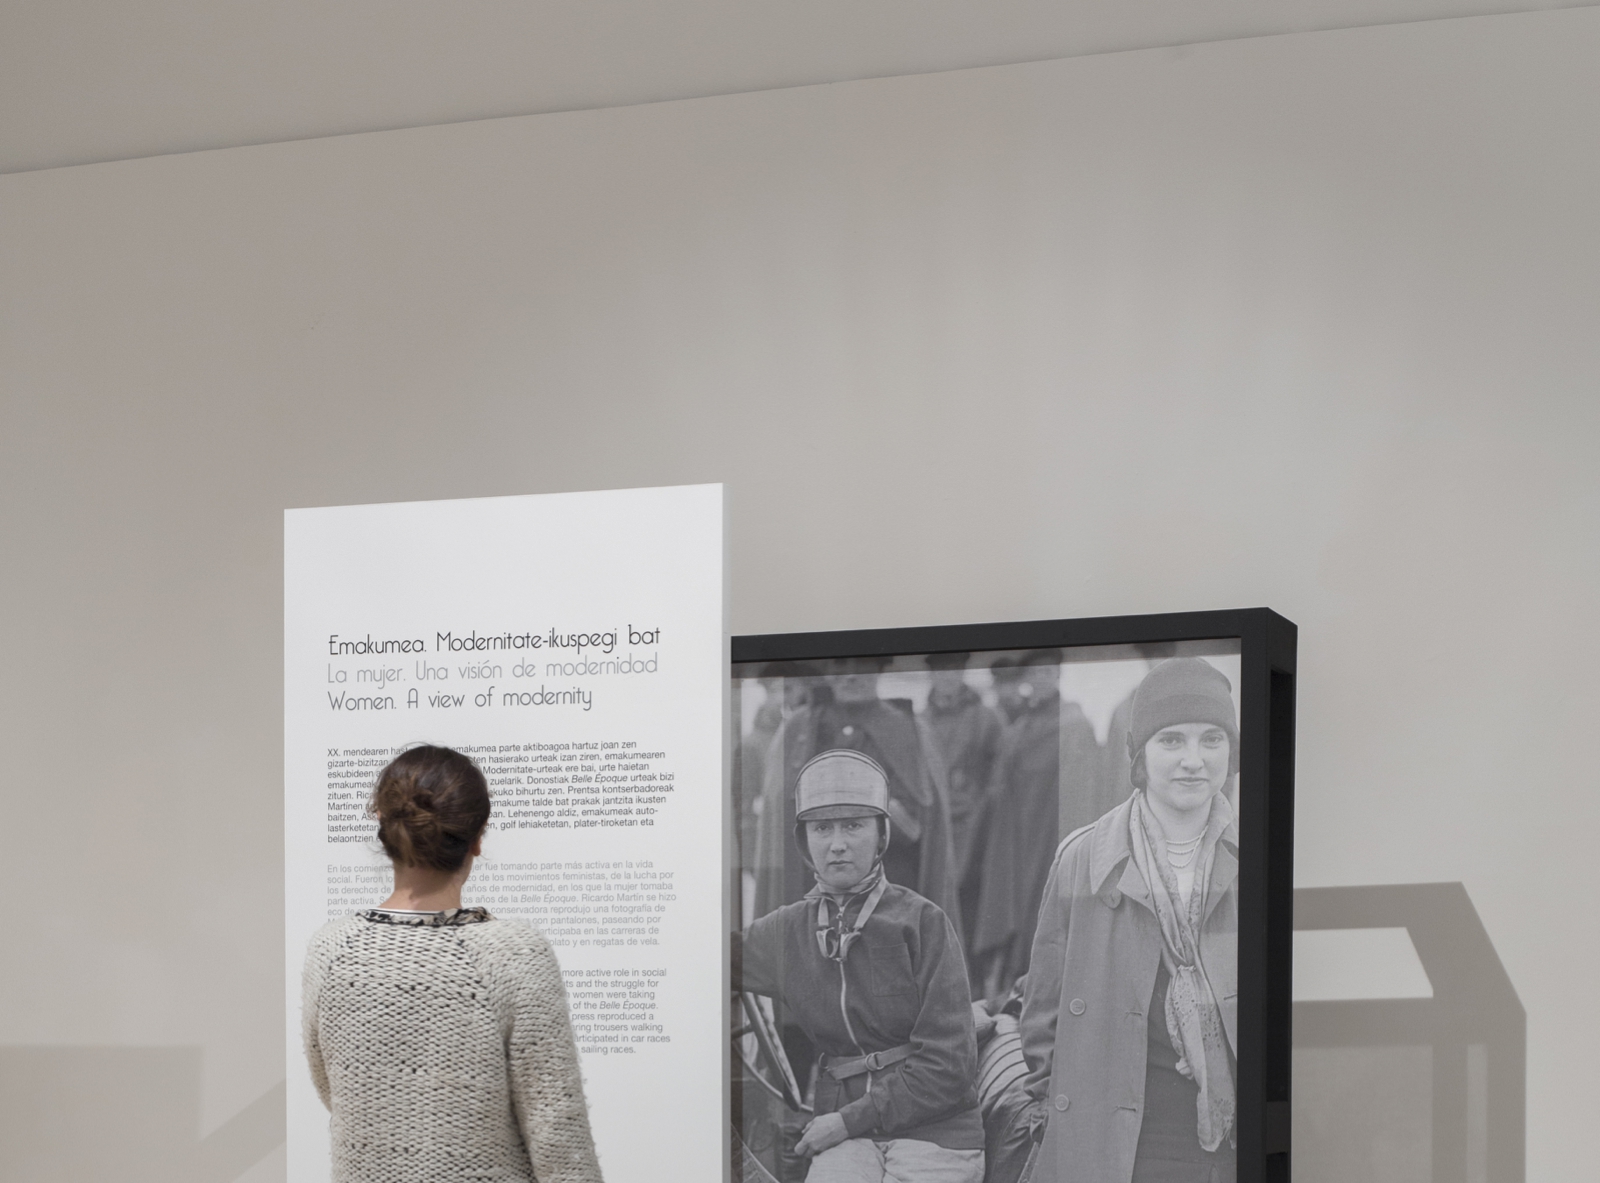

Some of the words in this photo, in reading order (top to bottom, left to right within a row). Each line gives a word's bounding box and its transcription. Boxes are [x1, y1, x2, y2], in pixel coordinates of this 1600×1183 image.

[328, 633, 427, 655] Emakumea.
[437, 627, 617, 655] Modernitate-ikuspegi
[629, 624, 660, 645] bat
[328, 663, 347, 683] La
[357, 665, 405, 690] mujer.
[416, 660, 448, 681] Una
[458, 660, 502, 679] visión
[512, 657, 536, 678] de
[546, 652, 657, 676] modernidad
[328, 687, 396, 711] Women.
[407, 688, 418, 709] A
[428, 690, 465, 708] view
[475, 685, 495, 707] of
[503, 684, 592, 711] modernity
[327, 748, 340, 757] XX.
[343, 747, 388, 756] mendearen
[499, 744, 521, 754] parte
[523, 742, 570, 754] aktiboagoa
[572, 742, 598, 750] hartuz
[601, 742, 619, 751] joan
[489, 754, 529, 764] hasierako
[531, 753, 558, 762] urteak
[560, 753, 577, 762] izan
[579, 752, 602, 761] ziren,
[605, 751, 665, 760] emakumearen
[327, 769, 374, 779] eskubideen
[483, 764, 563, 774] Modernitate-urteak
[581, 763, 596, 772] bai,
[599, 763, 616, 772] urte
[618, 762, 649, 771] haietan
[490, 776, 524, 786] zuelarik.
[527, 775, 569, 784] Donostiak
[571, 774, 593, 783] Belle
[595, 773, 628, 784] Époque
[630, 772, 657, 782] urteak
[660, 772, 674, 781] bizi
[328, 792, 353, 800] zituen.
[516, 787, 545, 796] bihurtu
[568, 785, 600, 794] Prentsa
[602, 783, 674, 794] kontserbadoreak
[328, 802, 363, 810] Martínen
[532, 797, 553, 806] talde
[556, 797, 569, 806] bat
[572, 796, 600, 807] prakak
[602, 796, 633, 807] jantzita
[636, 795, 666, 804] ikusten
[328, 813, 359, 821] baitzen,
[508, 809, 555, 821] Lehenengo
[557, 808, 579, 817] aldiz,
[581, 807, 633, 816] emakumeak
[636, 806, 658, 815] auto-
[500, 820, 516, 831] golf
[518, 820, 571, 829] lehiaketetan,
[574, 818, 638, 829] plater-tiroketan
[640, 818, 654, 826] eta
[328, 834, 374, 843] belaontzien
[328, 864, 337, 873] En
[485, 862, 498, 870] fue
[501, 862, 538, 870] tomando
[541, 862, 562, 871] parte
[565, 861, 582, 869] más
[585, 861, 610, 869] activa
[626, 860, 633, 868] la
[636, 860, 653, 868] vida
[327, 875, 352, 884] social.
[355, 873, 383, 883] Fueron
[479, 873, 490, 881] de
[492, 873, 504, 881] los
[507, 873, 560, 881] movimientos
[562, 872, 608, 880] feministas,
[624, 871, 631, 879] la
[634, 871, 657, 879] lucha
[660, 872, 674, 880] por
[327, 886, 339, 894] los
[341, 885, 378, 894] derechos
[381, 885, 391, 893] de
[467, 884, 487, 892] años
[489, 884, 500, 892] de
[502, 883, 555, 895] modernidad,
[571, 883, 583, 891] los
[586, 884, 602, 894] que
[604, 882, 611, 890] la
[614, 883, 638, 894] mujer
[640, 882, 673, 890] tomaba
[328, 897, 348, 906] parte
[475, 895, 495, 903] años
[498, 895, 508, 903] de
[511, 895, 518, 903] la
[520, 894, 541, 903] Belle
[544, 893, 578, 904] Époque.
[582, 893, 614, 902] Ricardo
[617, 893, 644, 901] Martín
[659, 893, 676, 901] hizo
[491, 905, 548, 915] conservadora
[551, 905, 591, 915] reprodujo
[612, 904, 652, 914] fotografía
[654, 904, 665, 912] de
[551, 916, 599, 925] pantalones,
[602, 915, 644, 925] paseando
[647, 916, 661, 927] por
[597, 926, 609, 935] las
[648, 926, 659, 934] de
[573, 940, 577, 948] y
[593, 938, 624, 948] regatas
[627, 937, 638, 945] de
[640, 937, 659, 945] vela.
[586, 969, 611, 977] active
[614, 968, 629, 976] role
[642, 968, 666, 977] social
[576, 979, 592, 988] and
[595, 979, 608, 988] the
[611, 979, 645, 990] struggle
[647, 979, 659, 987] for
[628, 990, 655, 1000] taking
[573, 1000, 581, 1009] of
[584, 1001, 597, 1009] the
[600, 1000, 620, 1009] Belle
[623, 1000, 658, 1011] Époque.
[598, 1012, 646, 1022] reproduced
[631, 1023, 663, 1034] walking
[581, 1045, 608, 1055] sailing
